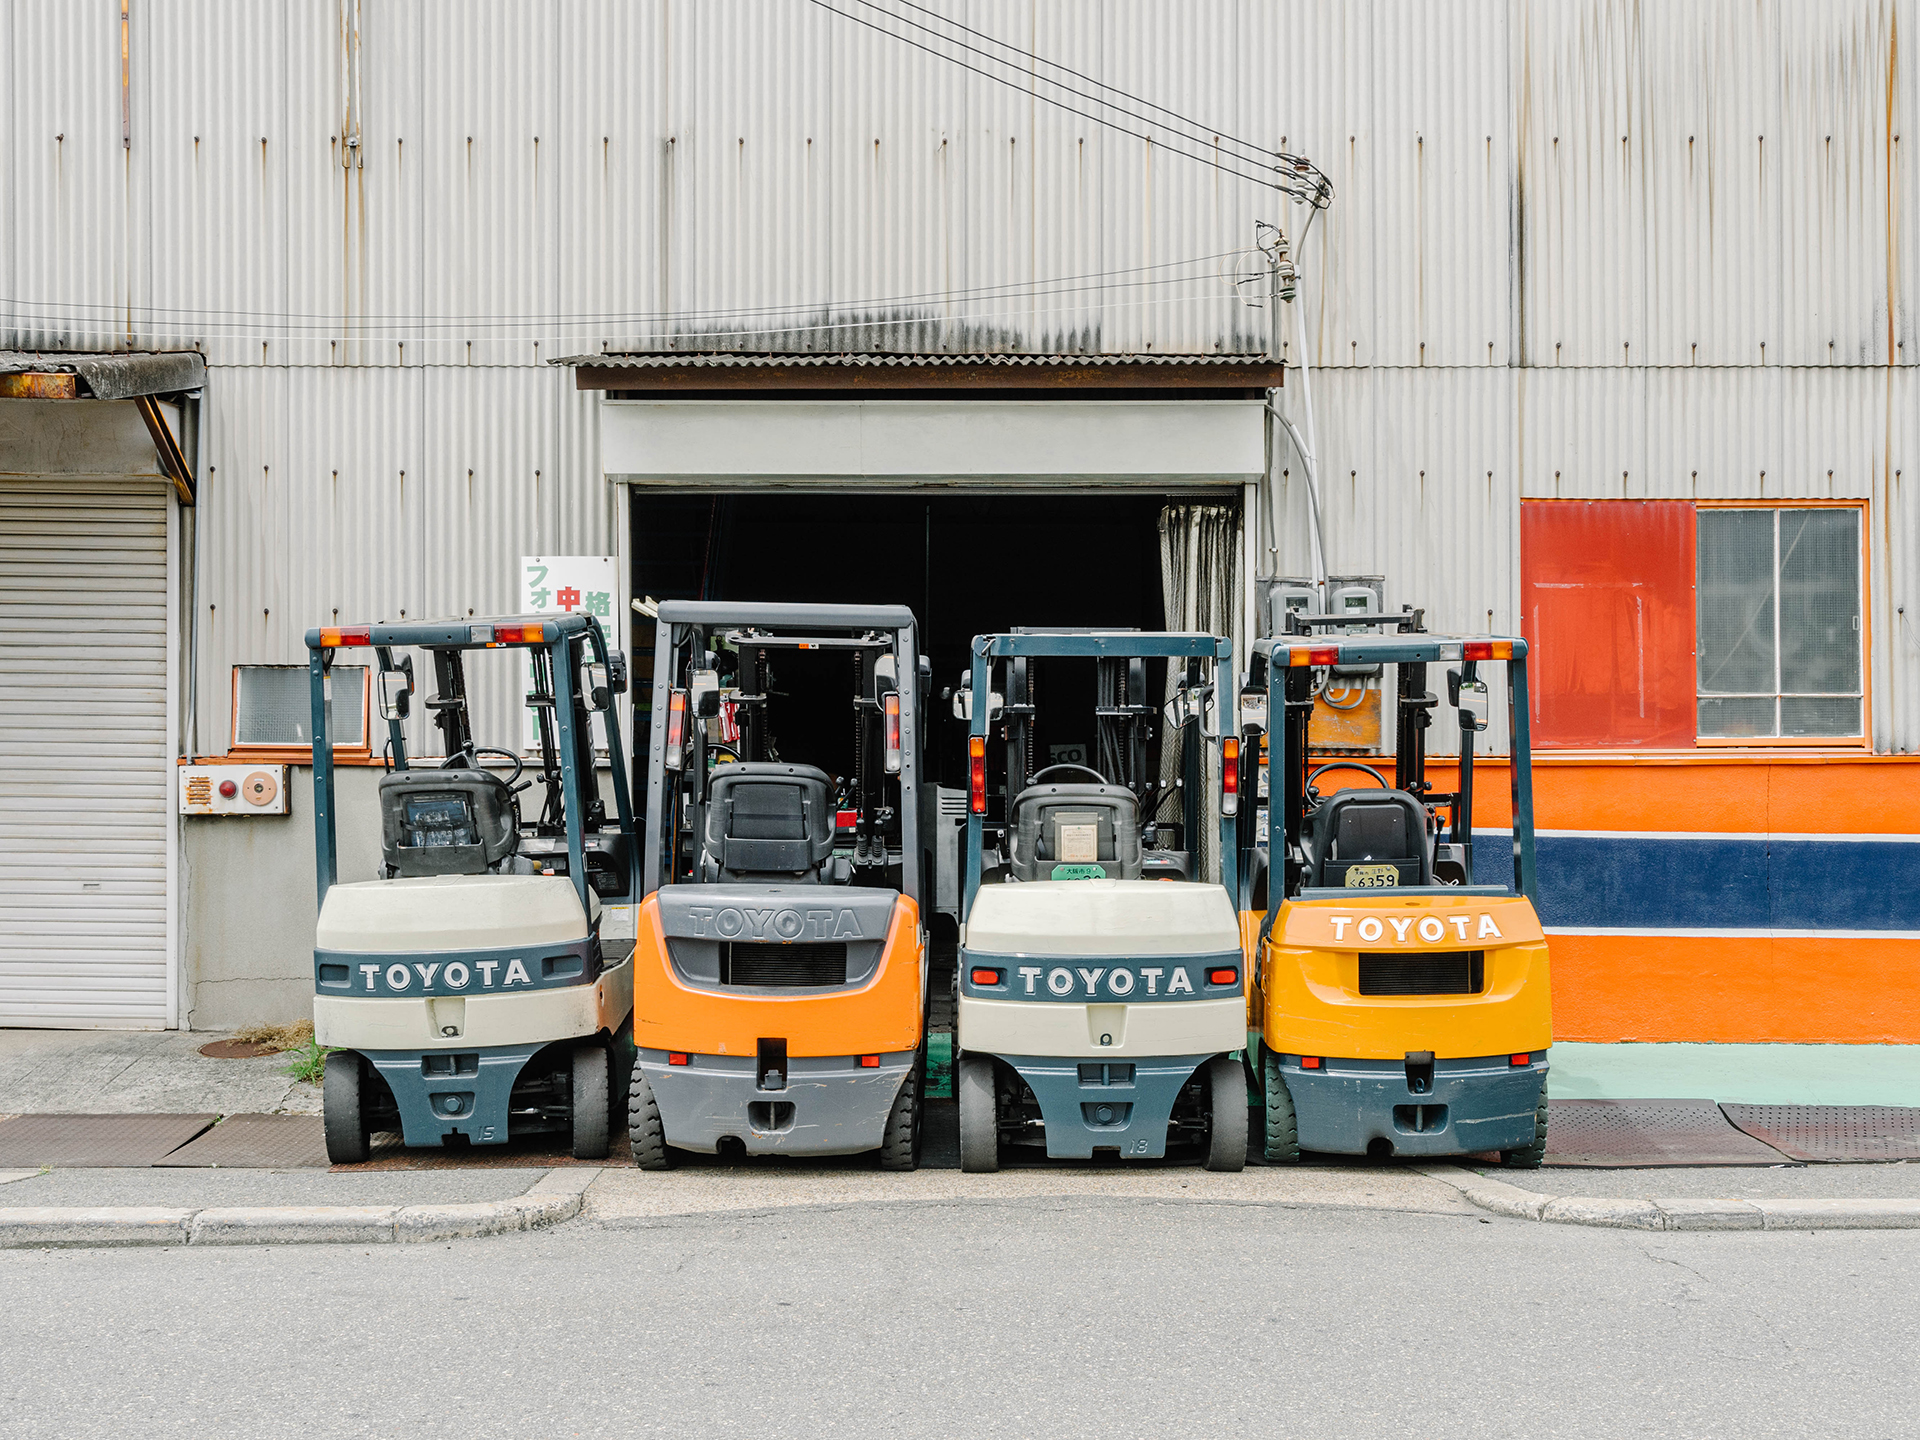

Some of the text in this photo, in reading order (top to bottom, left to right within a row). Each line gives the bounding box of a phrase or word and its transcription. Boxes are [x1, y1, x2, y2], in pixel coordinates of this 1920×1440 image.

[688, 906, 864, 940] TOYOTA
[1328, 913, 1503, 943] TOYOTA
[358, 958, 534, 992] TOYOTA
[1018, 965, 1196, 997] TOYOTA
[478, 1125, 495, 1141] 15
[1130, 1139, 1149, 1154] 18
